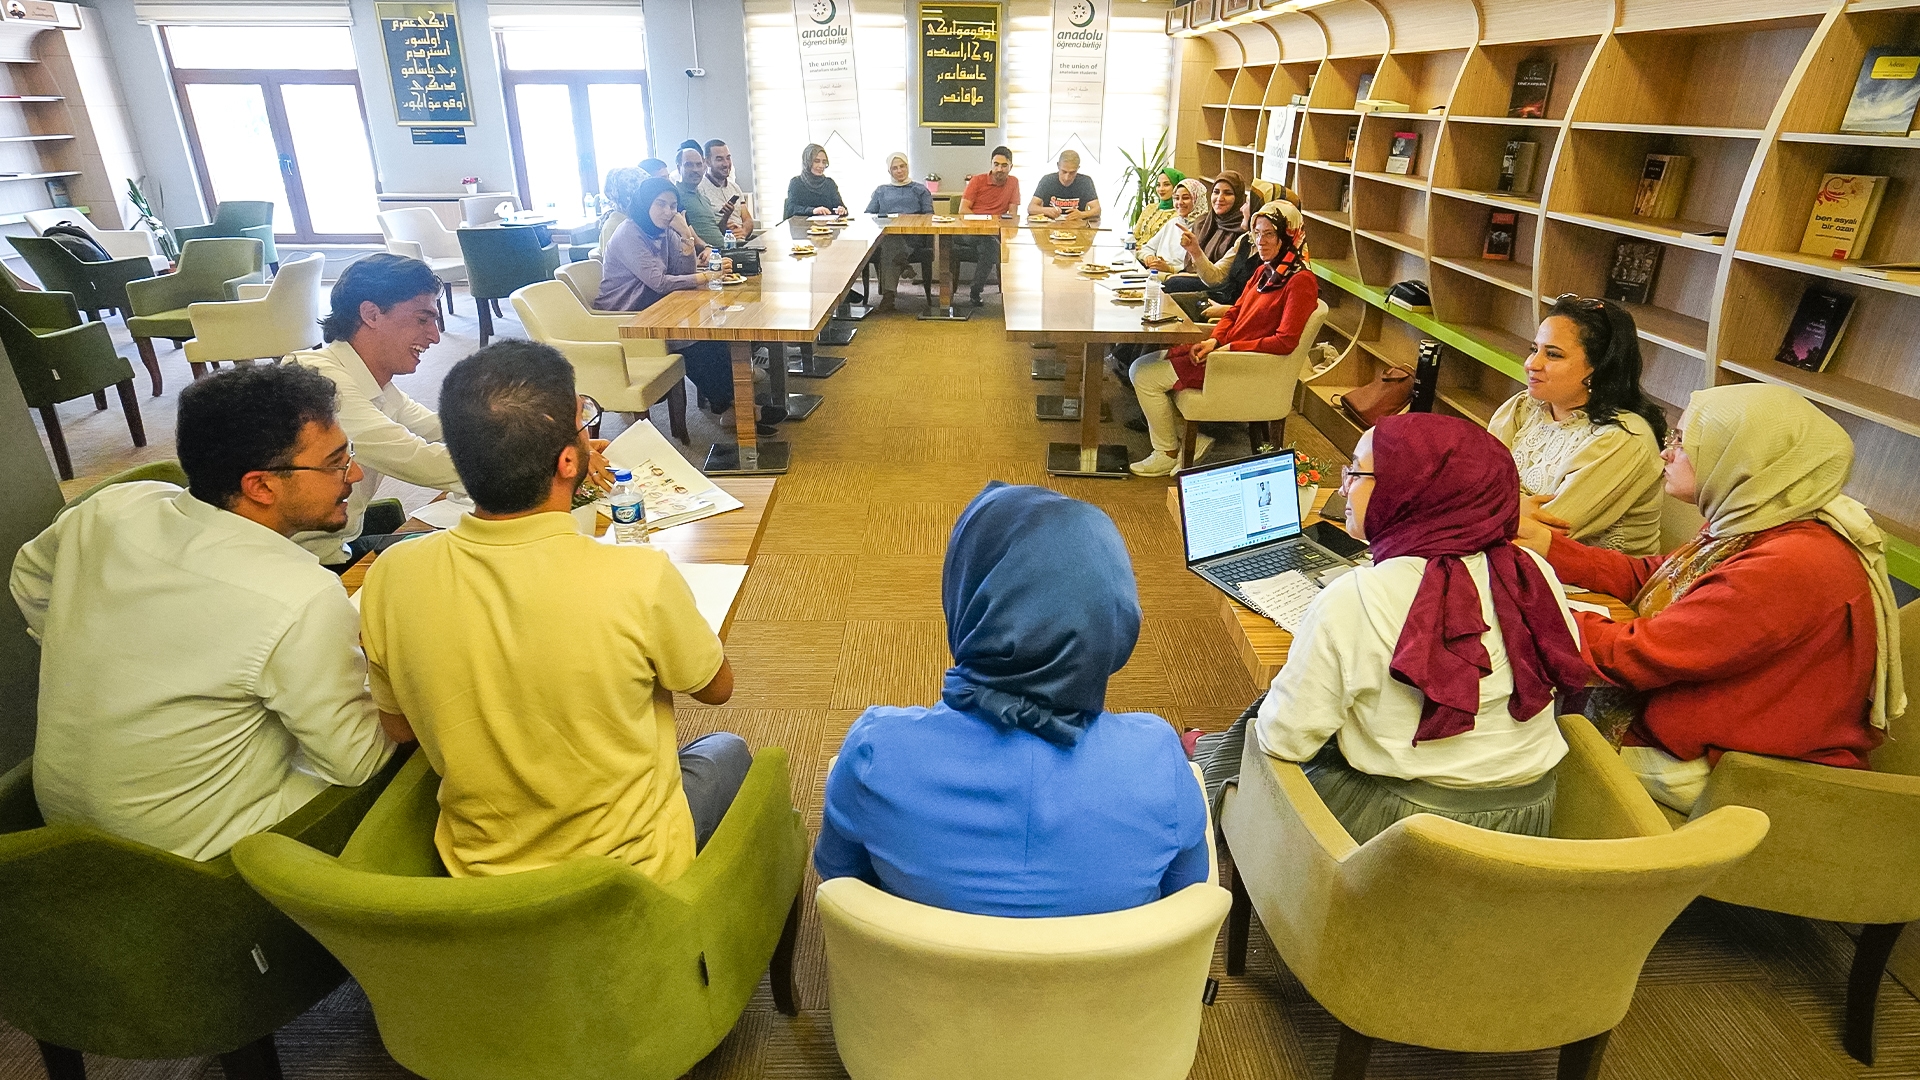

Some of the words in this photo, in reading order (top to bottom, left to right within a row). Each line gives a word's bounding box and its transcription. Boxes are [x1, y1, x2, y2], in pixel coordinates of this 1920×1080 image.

[801, 25, 848, 39] anadolu
[1057, 29, 1103, 41] anadolu
[802, 38, 828, 48] öğrenci
[828, 37, 848, 46] birliği
[1056, 40, 1082, 50] öğrenci
[1082, 41, 1102, 51] birliği
